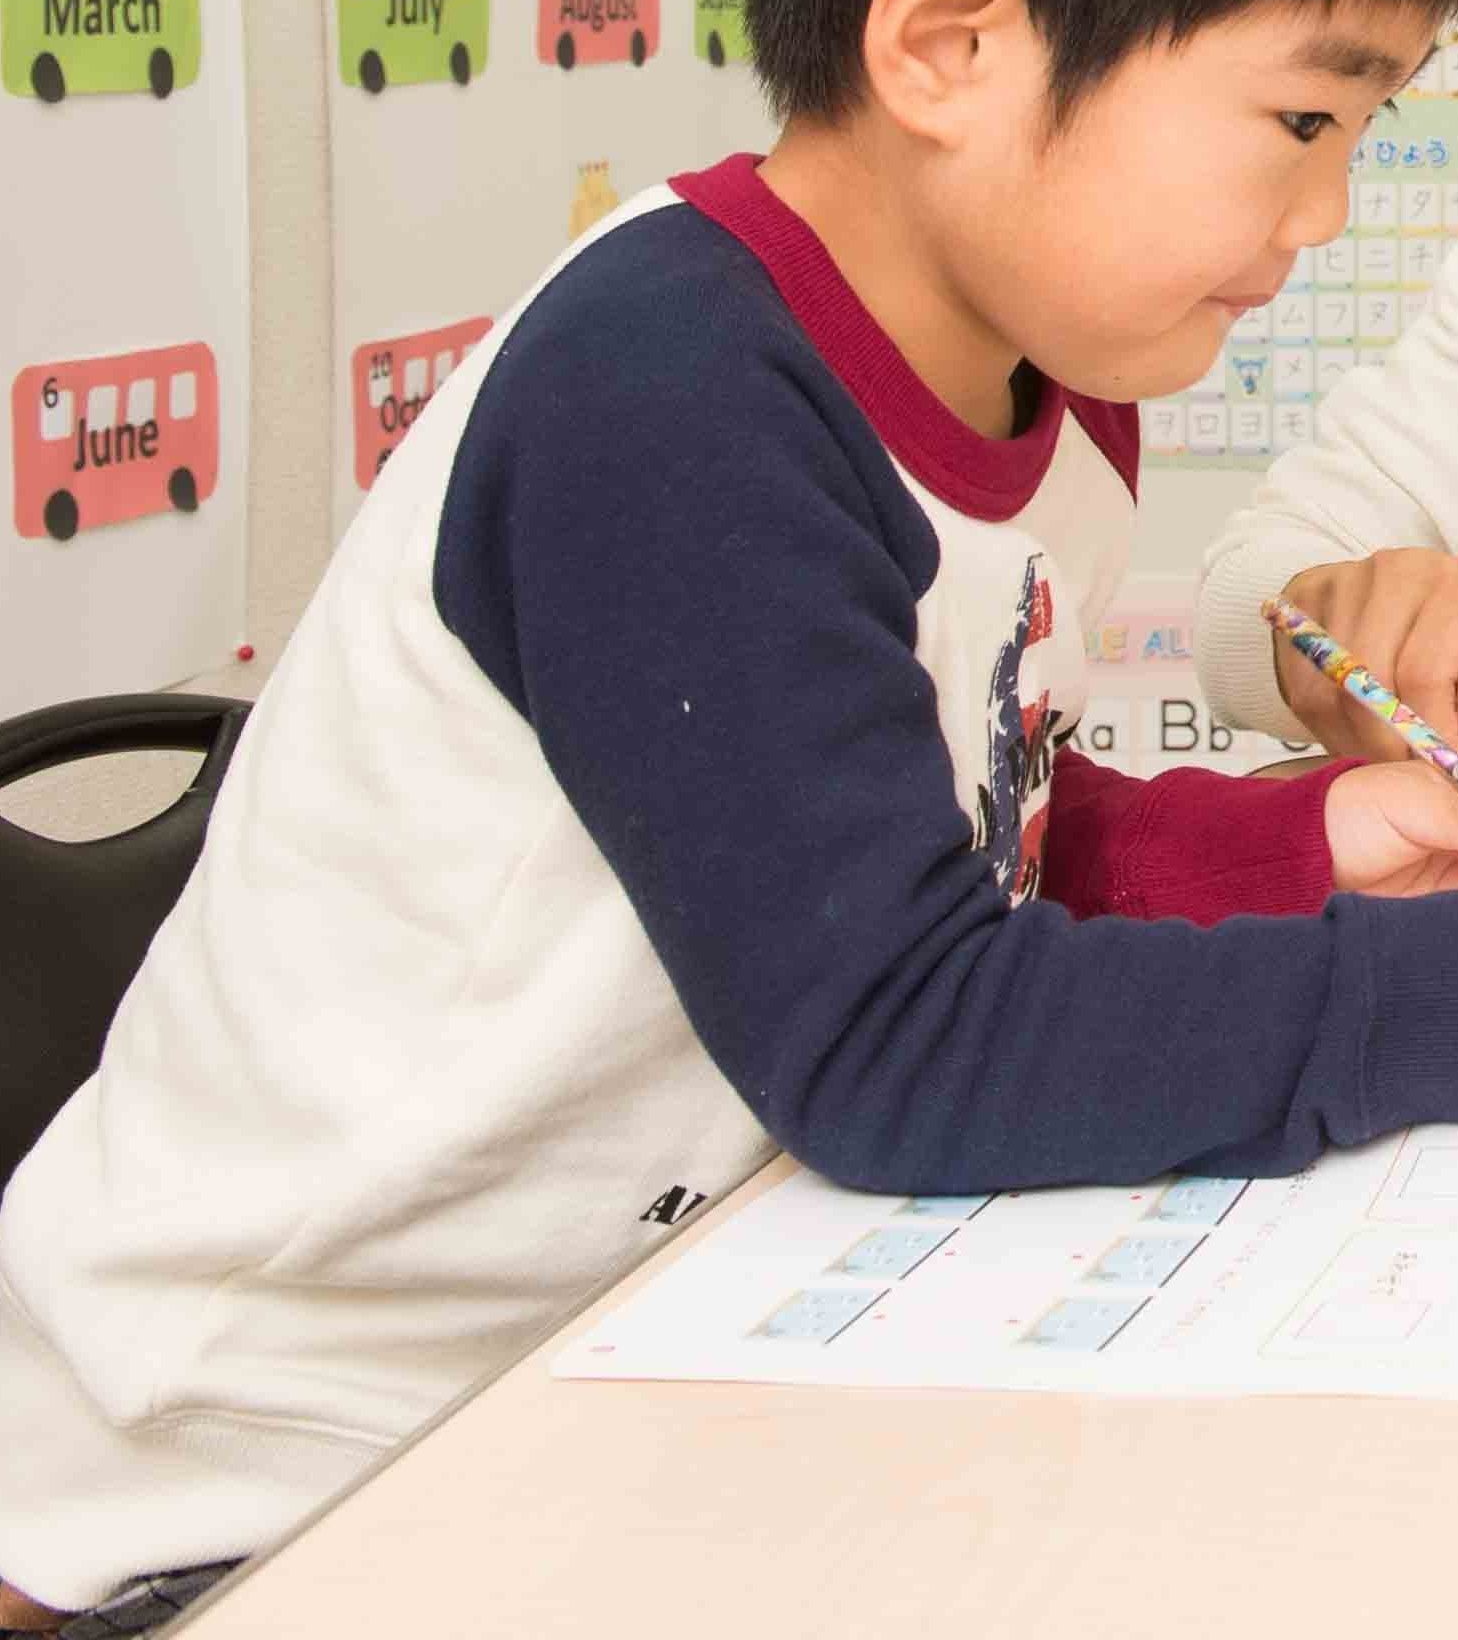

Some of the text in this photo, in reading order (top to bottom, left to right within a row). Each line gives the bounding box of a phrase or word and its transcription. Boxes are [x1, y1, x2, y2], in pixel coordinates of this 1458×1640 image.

[371, 351, 394, 380] 10
[42, 376, 59, 409] 6
[73, 418, 159, 472] June
[1144, 626, 1193, 658] AL
